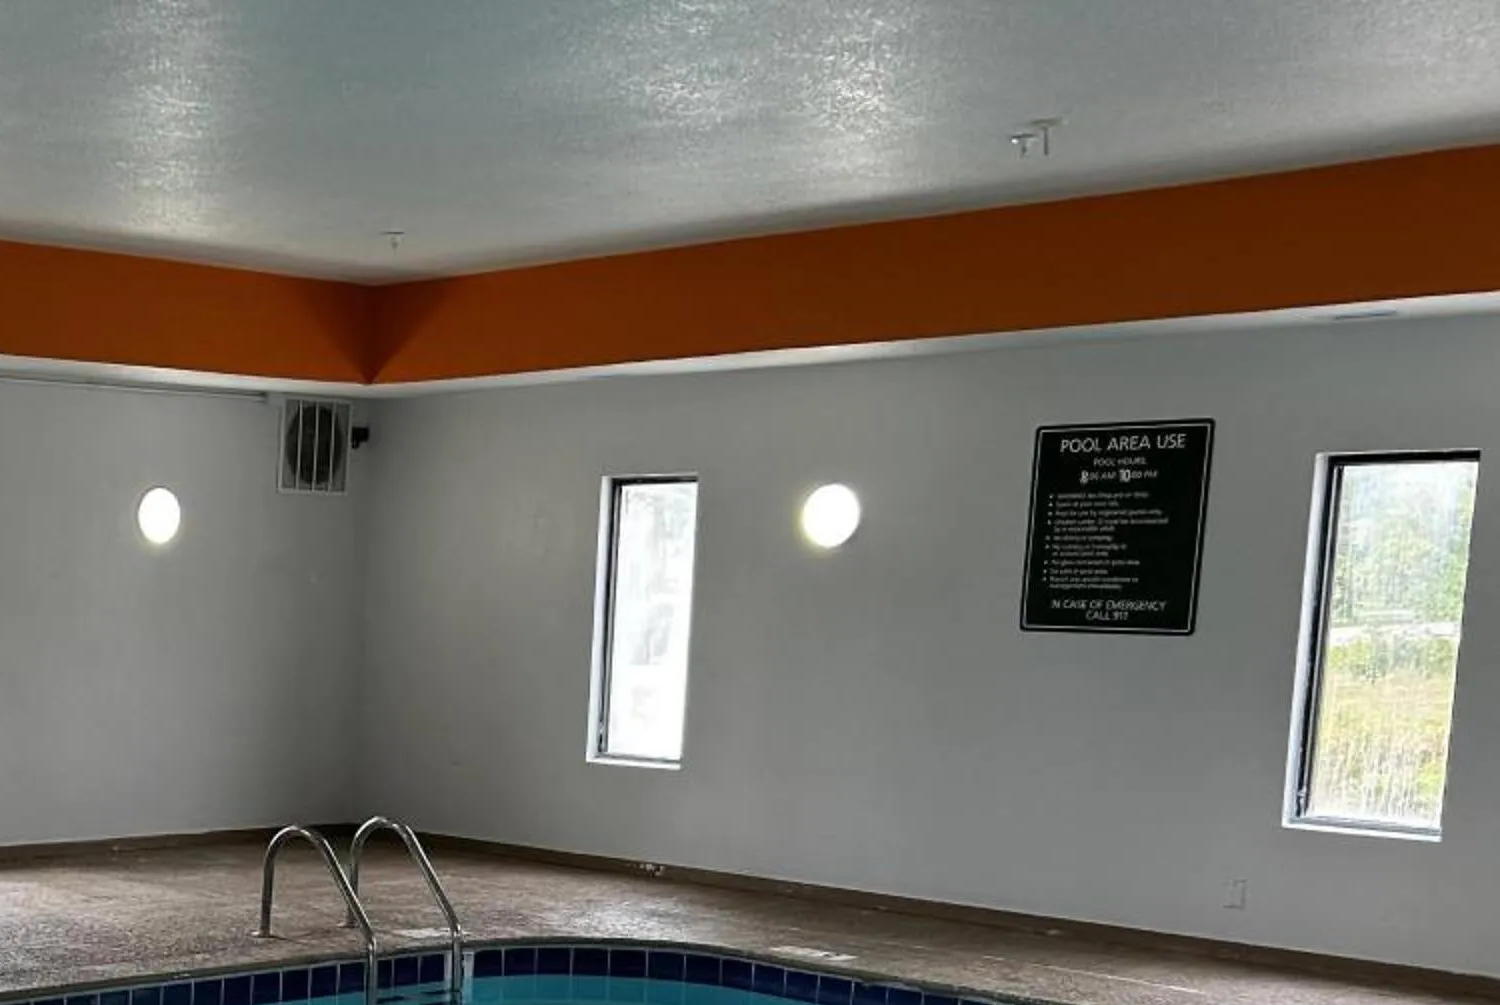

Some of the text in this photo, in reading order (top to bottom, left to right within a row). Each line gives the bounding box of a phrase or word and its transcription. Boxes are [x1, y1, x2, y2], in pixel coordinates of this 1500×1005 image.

[1060, 433, 1187, 453] POOL AREA USE
